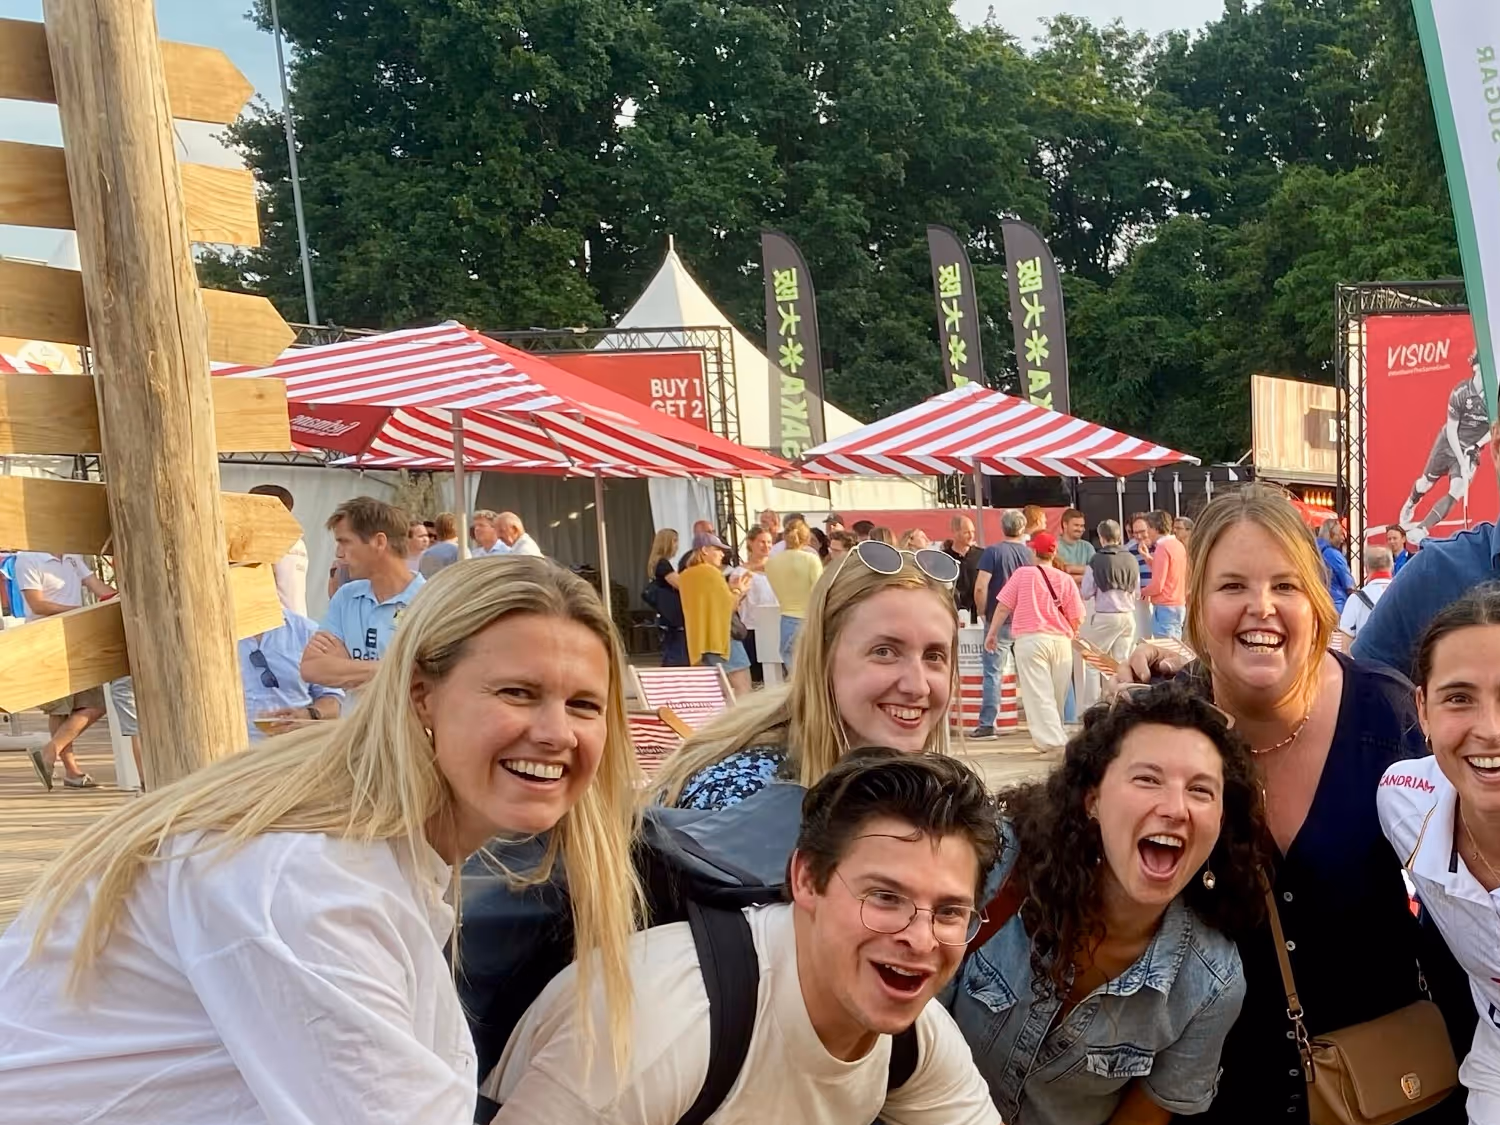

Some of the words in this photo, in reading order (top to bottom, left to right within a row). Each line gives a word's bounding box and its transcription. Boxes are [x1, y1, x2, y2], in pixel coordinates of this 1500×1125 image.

[1388, 338, 1450, 370] VISION
[650, 378, 688, 398] BUY
[692, 378, 701, 398] 1
[651, 400, 687, 418] GET
[691, 400, 704, 418] 2
